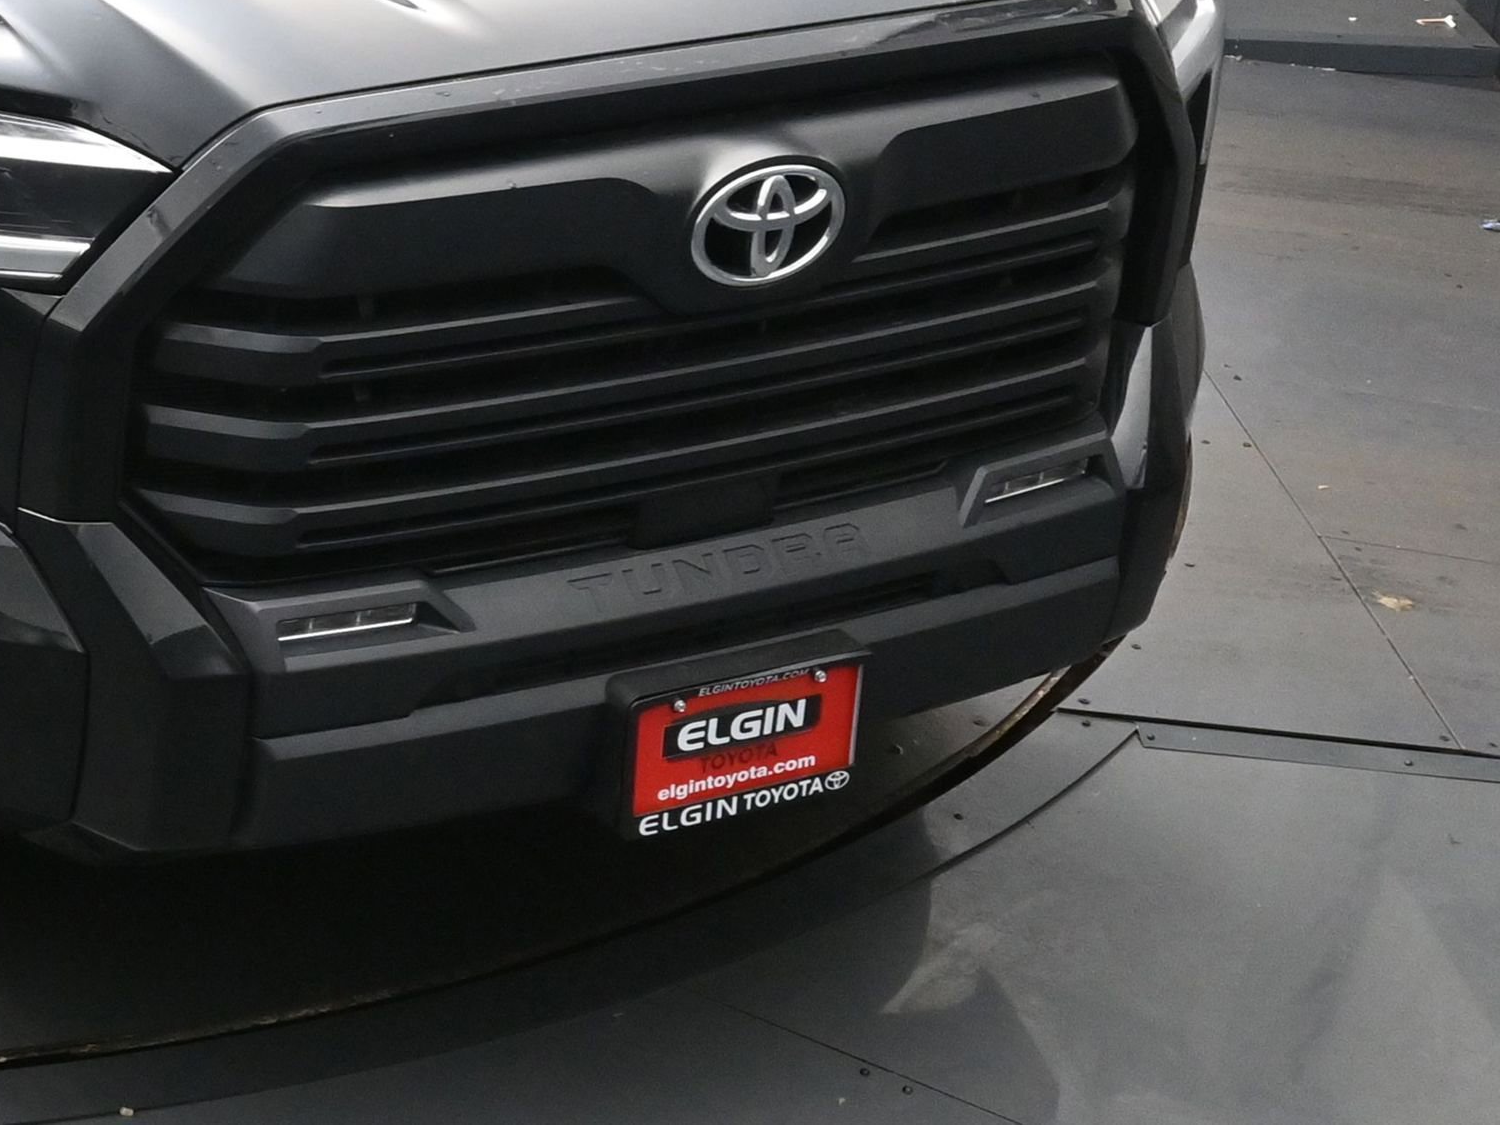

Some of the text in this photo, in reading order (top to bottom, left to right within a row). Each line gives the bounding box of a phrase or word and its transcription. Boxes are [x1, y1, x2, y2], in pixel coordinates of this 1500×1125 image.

[566, 522, 873, 617] TUNDRA
[698, 668, 810, 697] ELGINTOYOTA.COM
[677, 698, 806, 752] ELGIN
[656, 754, 816, 801] elgintoyota.com
[700, 742, 779, 773] TOYOTA
[638, 778, 824, 837] ELGIN TOYOTA
